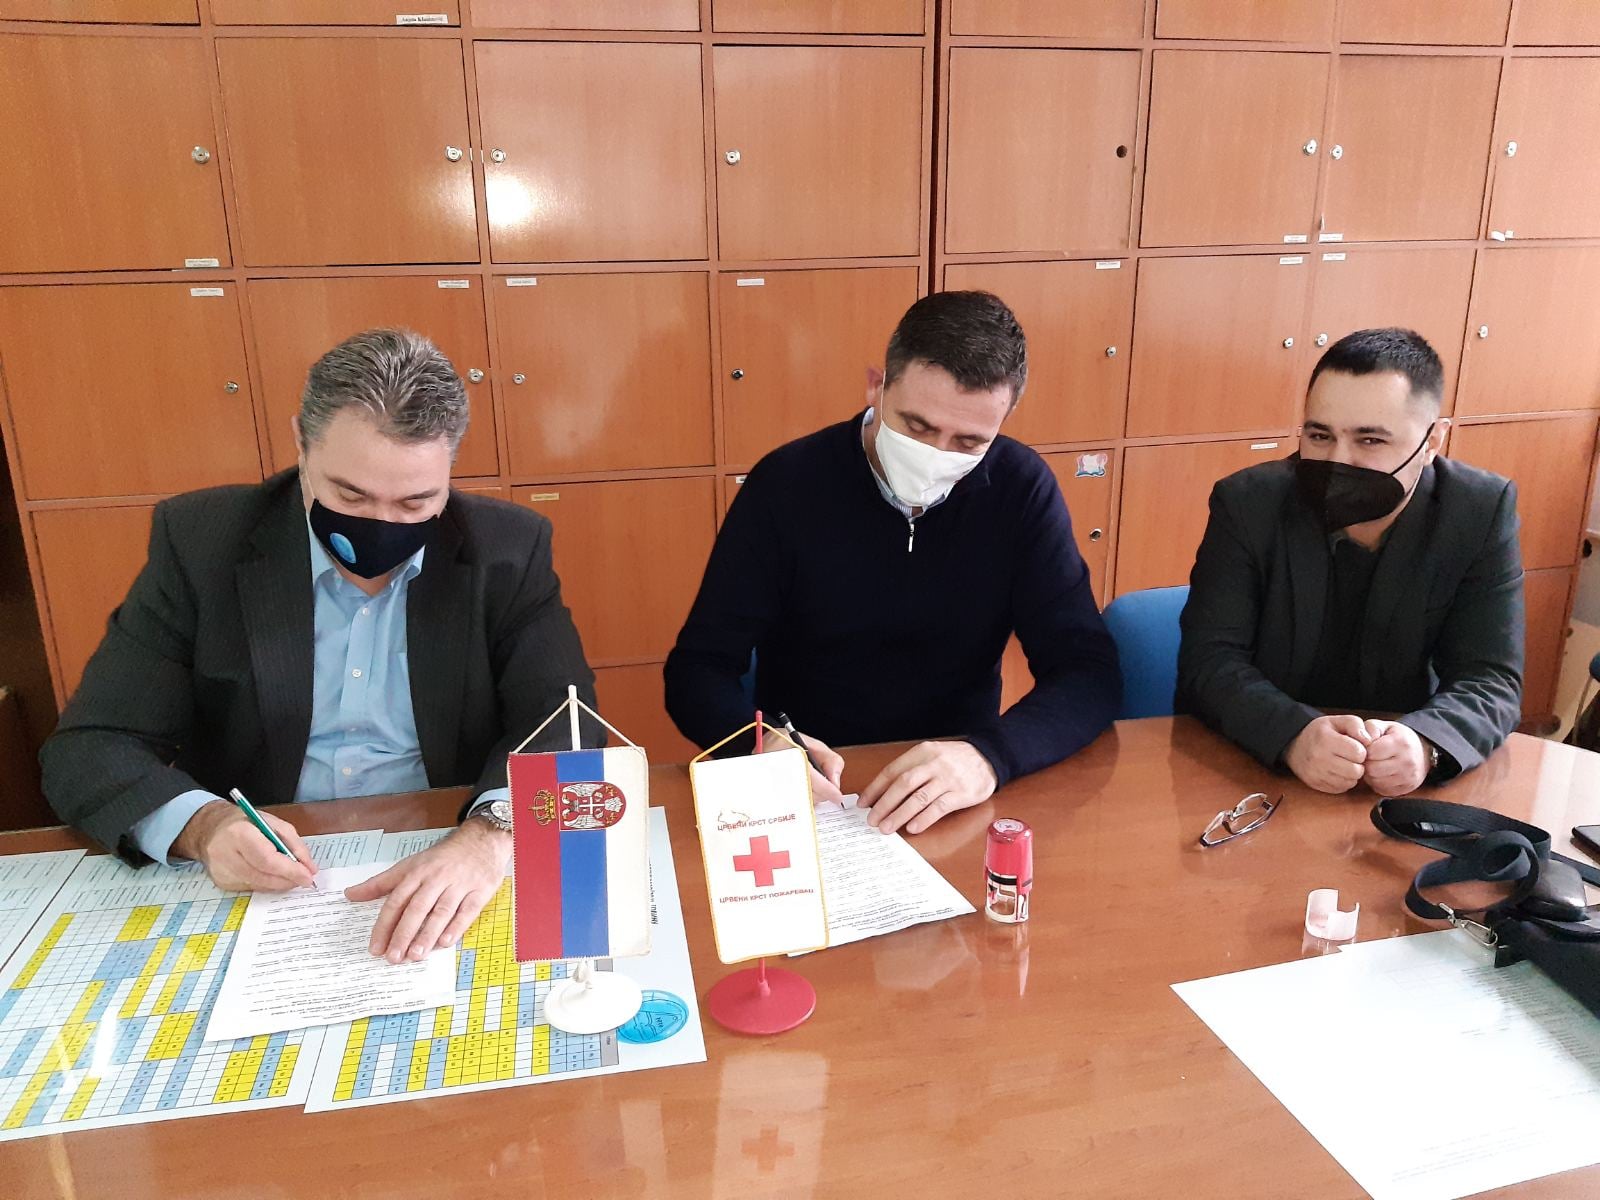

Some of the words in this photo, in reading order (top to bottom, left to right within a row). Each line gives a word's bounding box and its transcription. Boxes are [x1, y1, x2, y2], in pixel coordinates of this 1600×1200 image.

[748, 819, 767, 829] КРСТ
[768, 814, 796, 825] СРБИЈЕ
[719, 895, 749, 904] ЦРВЕНИ
[750, 893, 767, 901] КРСТ
